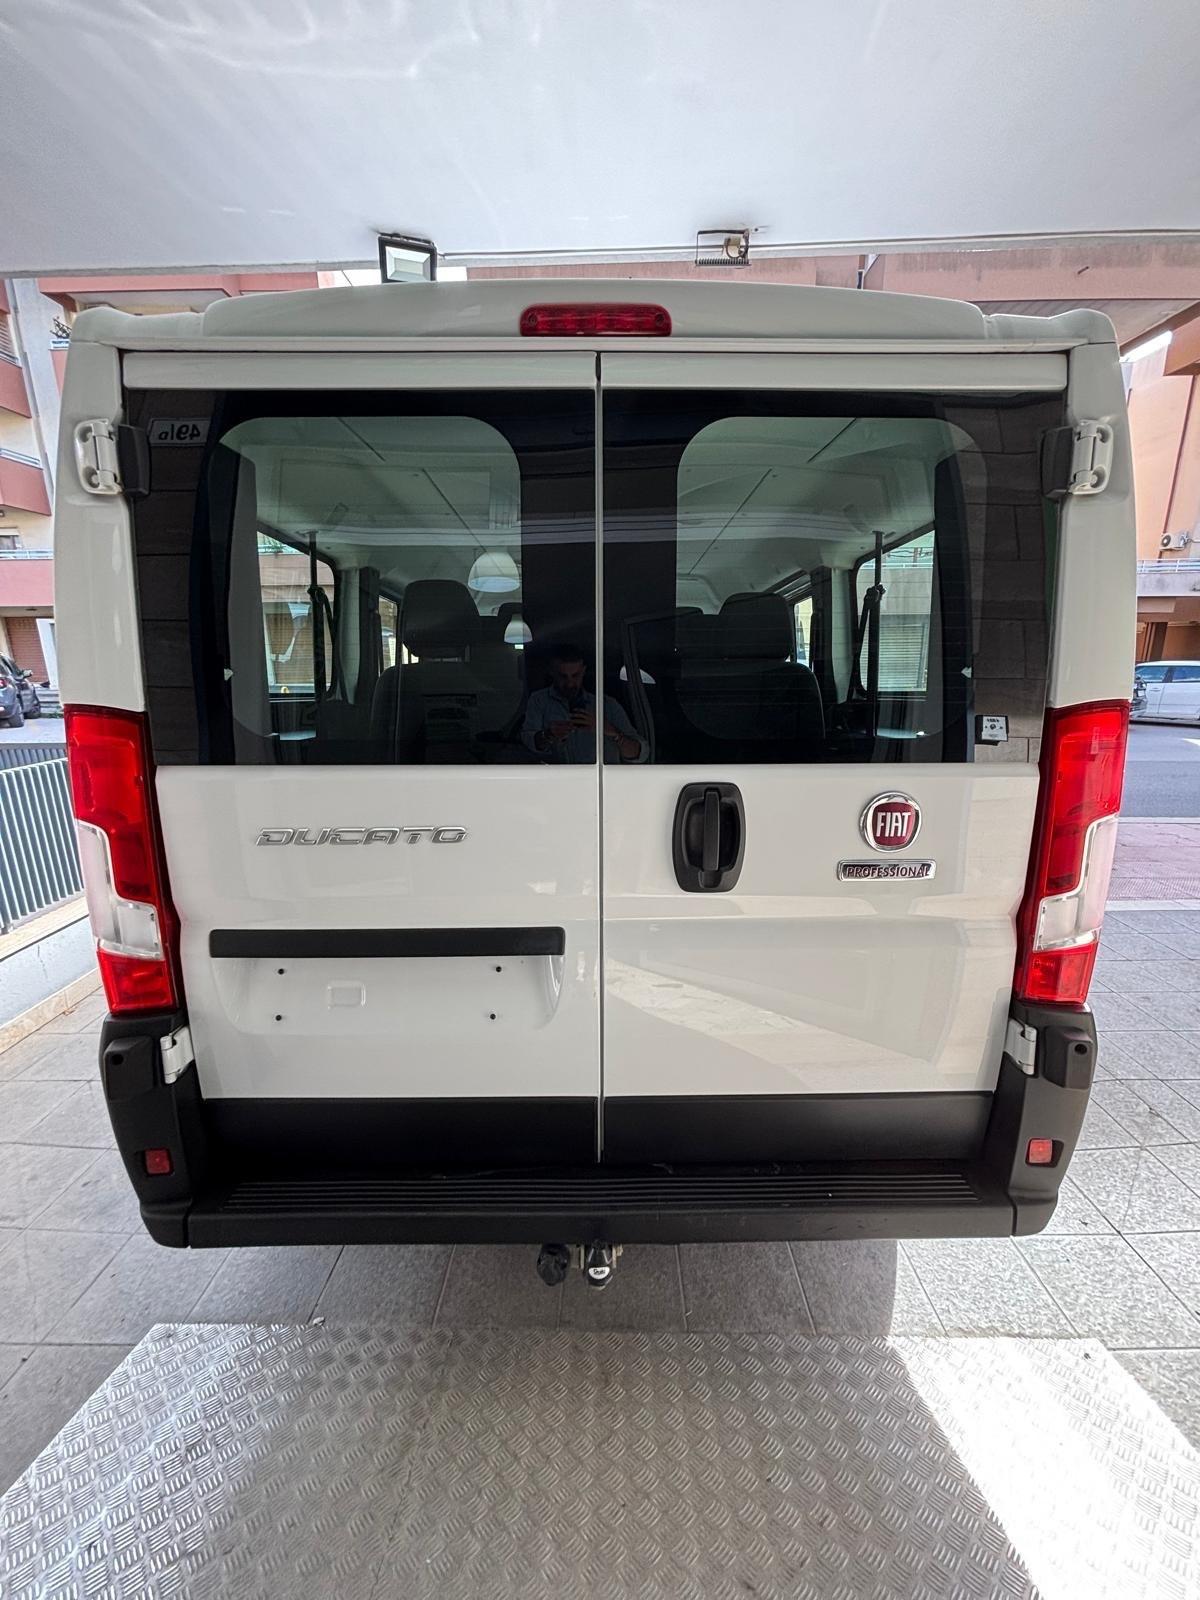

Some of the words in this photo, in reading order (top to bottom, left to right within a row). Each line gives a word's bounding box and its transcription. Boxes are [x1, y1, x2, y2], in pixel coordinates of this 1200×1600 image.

[876, 811, 911, 838] FIAT
[256, 825, 467, 846] DUCATO
[846, 866, 931, 878] PROFESSIONAL
